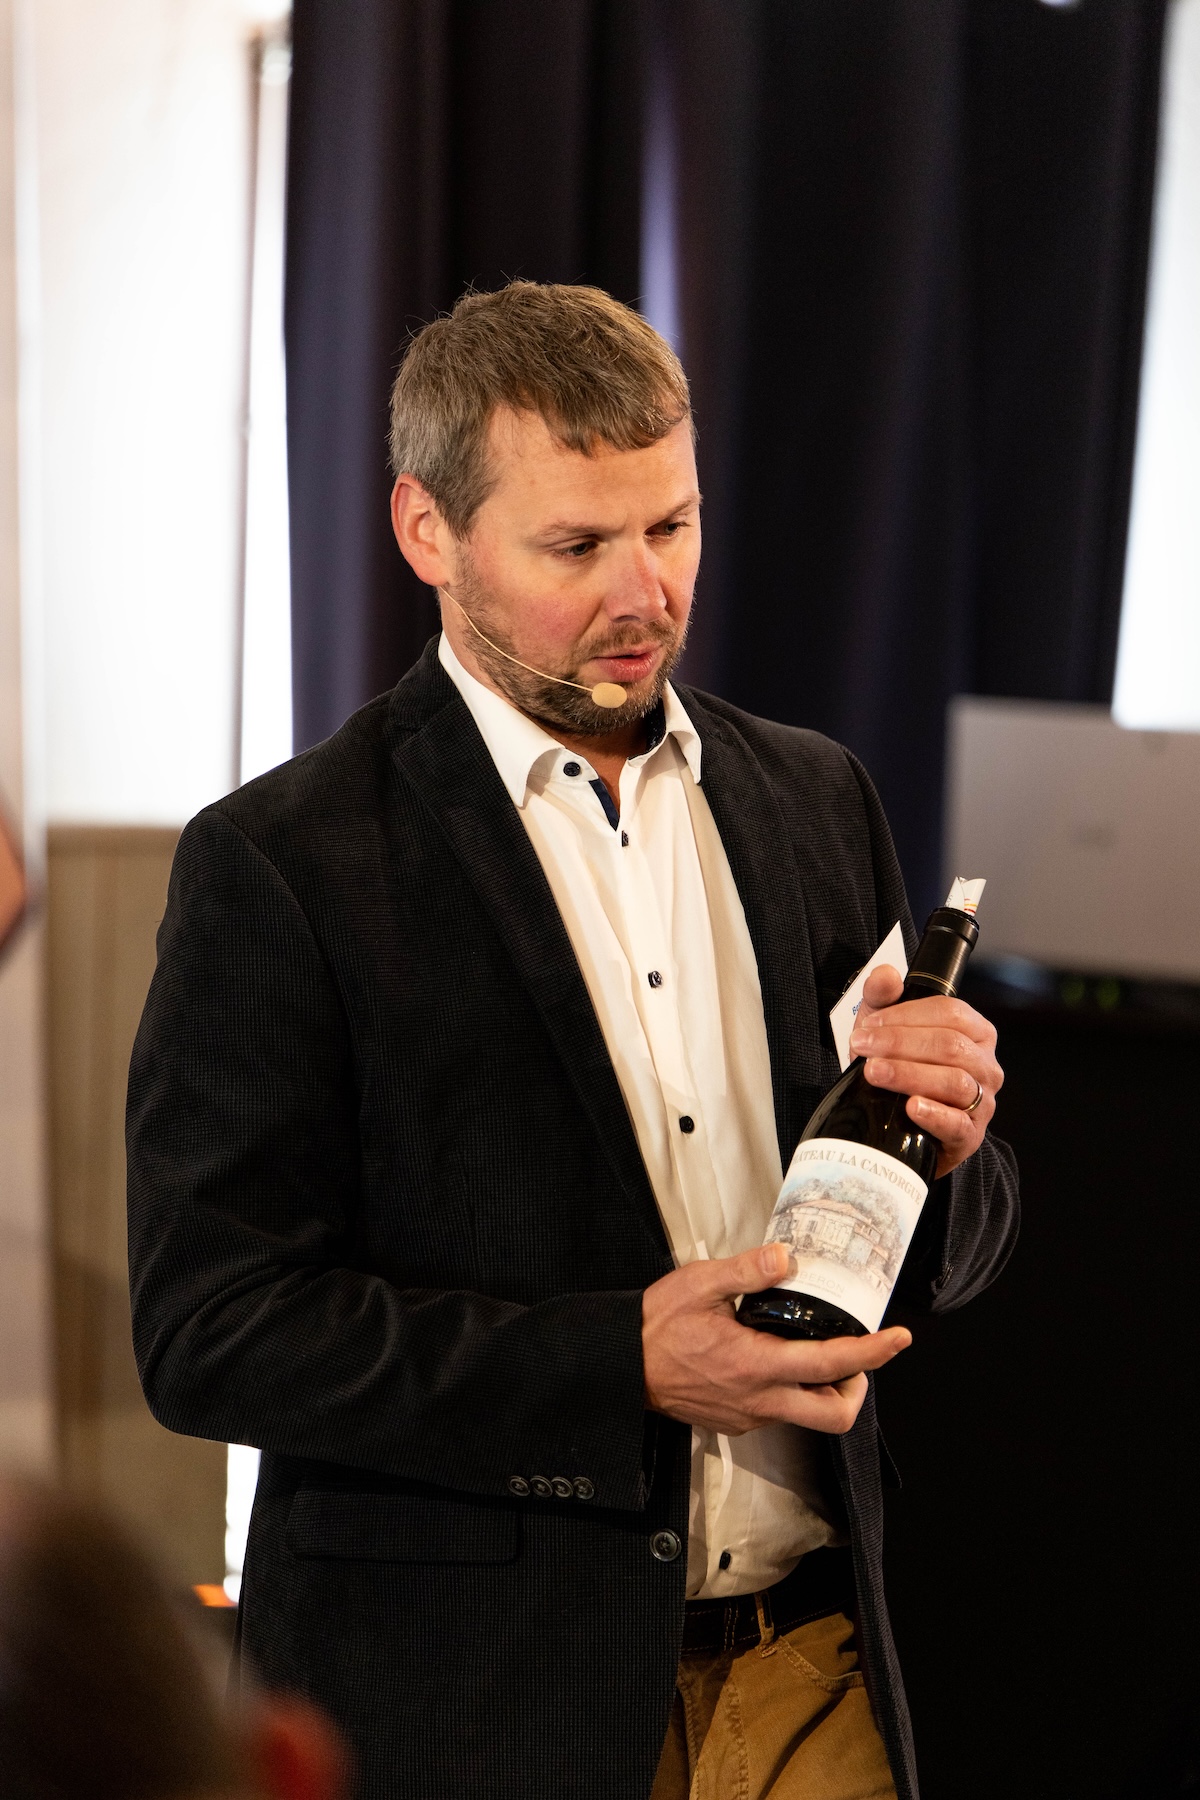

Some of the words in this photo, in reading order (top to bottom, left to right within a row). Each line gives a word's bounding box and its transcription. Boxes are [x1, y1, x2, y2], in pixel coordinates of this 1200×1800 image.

[838, 1152, 857, 1167] LA
[860, 1158, 922, 1205] CANORGUE
[798, 1271, 845, 1294] BERON
